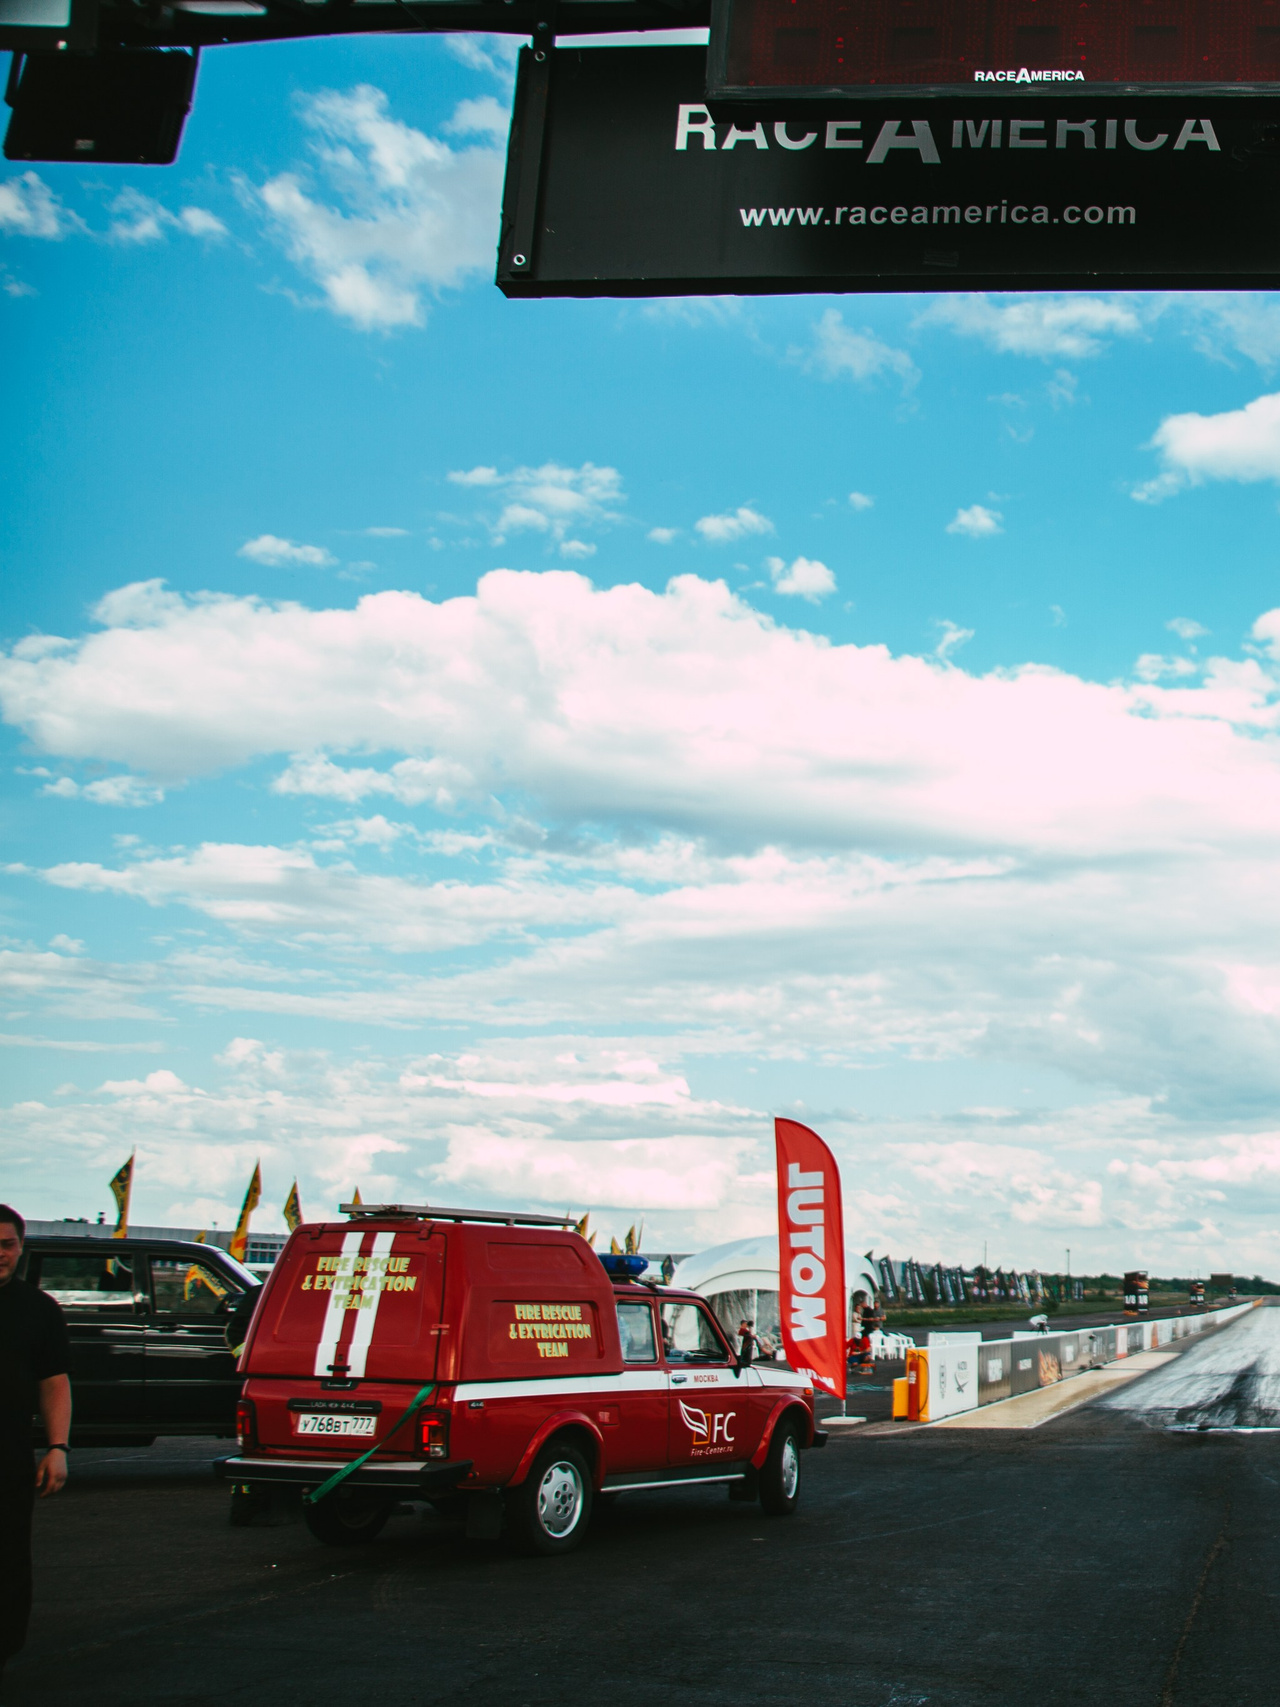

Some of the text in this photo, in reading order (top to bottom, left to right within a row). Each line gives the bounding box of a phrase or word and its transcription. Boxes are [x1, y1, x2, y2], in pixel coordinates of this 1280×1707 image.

[974, 67, 1085, 84] RACEAMERICA
[738, 200, 1137, 228] www.raceamerica.com
[316, 1256, 411, 1273] FIRE RESCUE
[301, 1275, 417, 1292] & EXTRICATION
[333, 1294, 375, 1310] TEAM
[515, 1304, 582, 1321] FIRE RESCUE
[509, 1323, 592, 1339] & EXTRICATION
[537, 1342, 569, 1358] TEAM
[693, 1374, 719, 1383] МОСКВА
[352, 1417, 373, 1430] 777
[713, 1412, 737, 1443] FC
